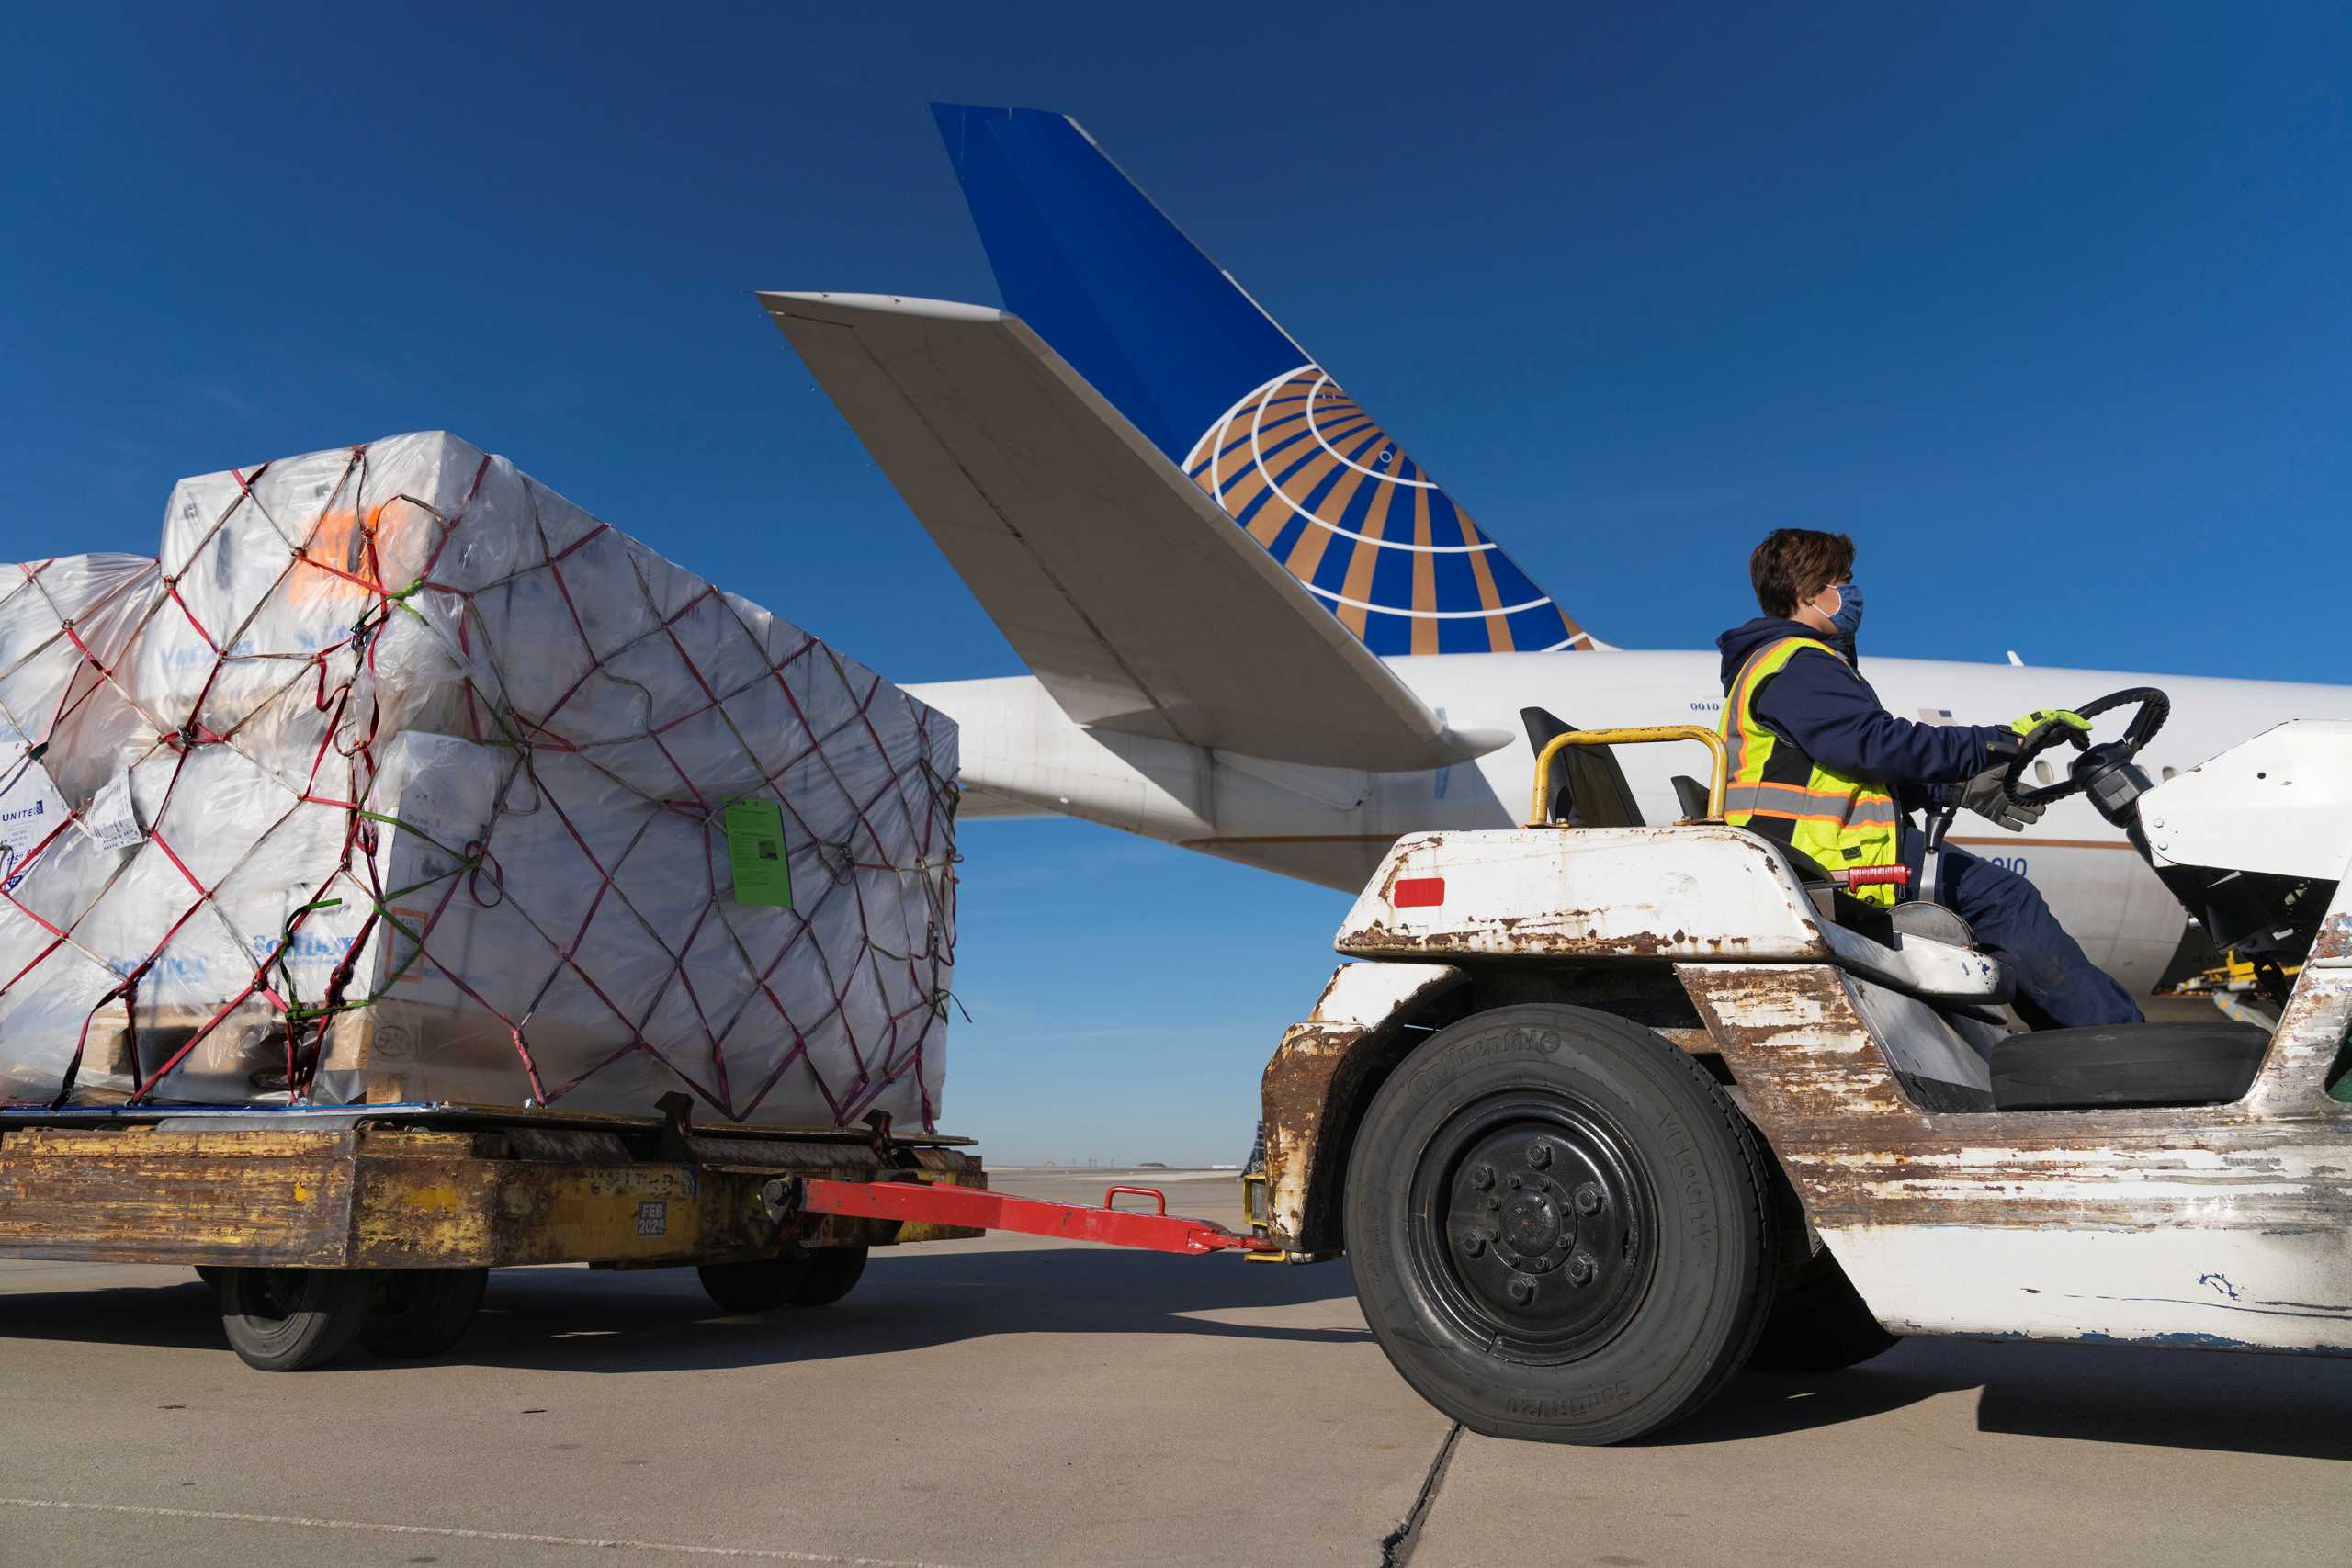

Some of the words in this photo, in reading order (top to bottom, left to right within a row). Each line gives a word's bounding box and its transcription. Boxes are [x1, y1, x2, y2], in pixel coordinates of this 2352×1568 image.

[1690, 702, 1720, 711] 0010
[2, 807, 37, 822] UNITE
[642, 1204, 663, 1218] FEB
